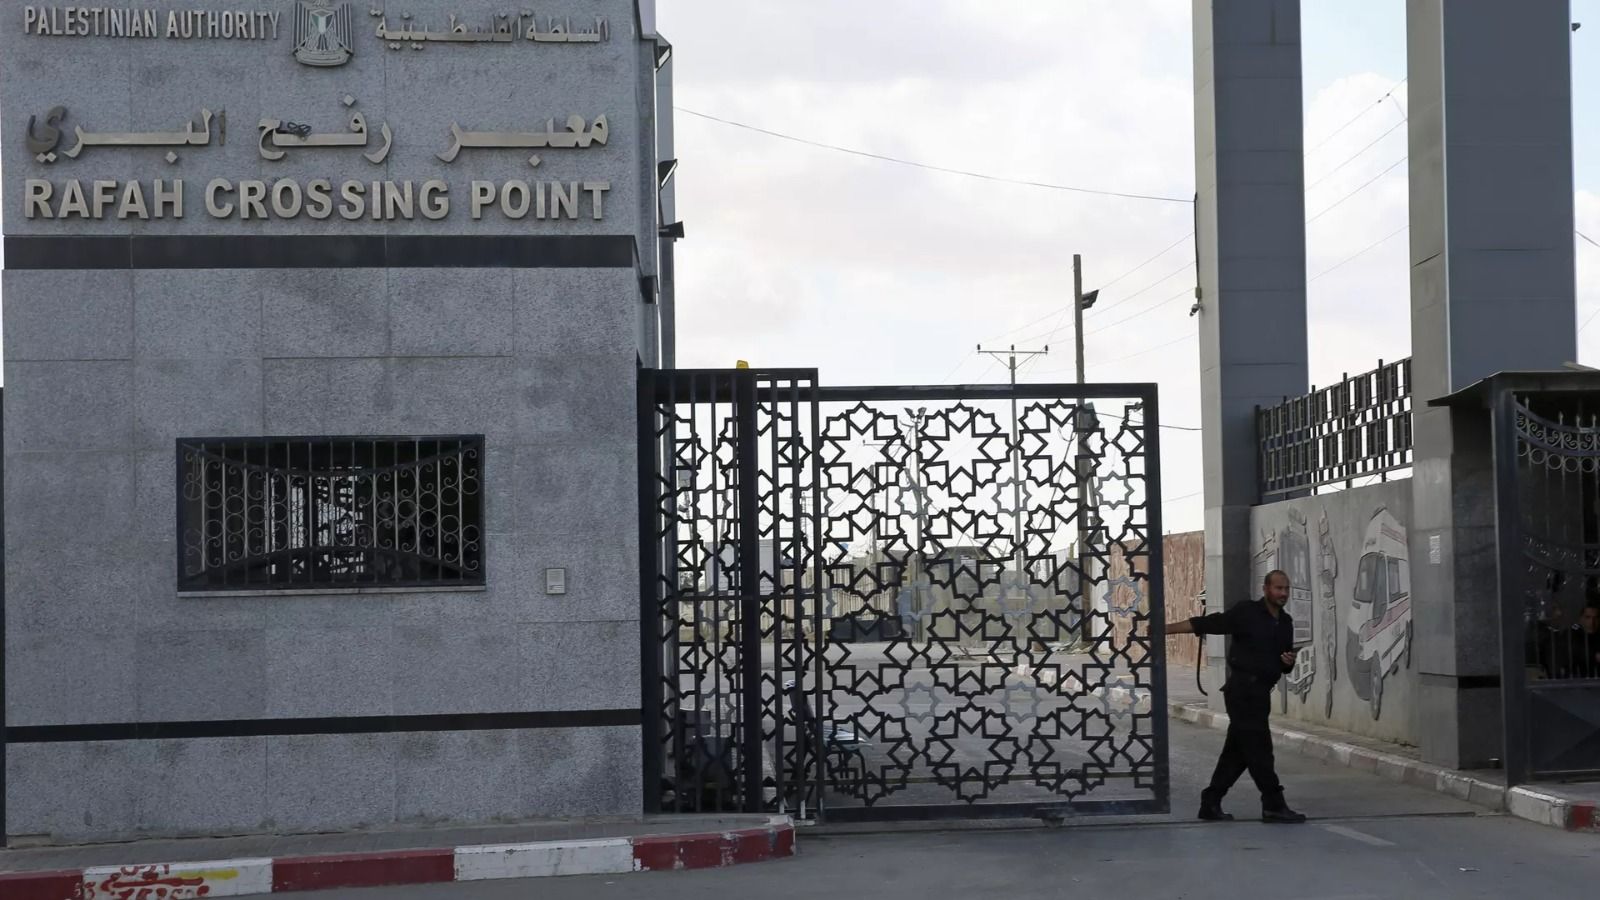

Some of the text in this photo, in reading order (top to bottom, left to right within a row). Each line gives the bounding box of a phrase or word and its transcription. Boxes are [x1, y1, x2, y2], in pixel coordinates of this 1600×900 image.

[24, 7, 280, 39] PALESTINIAN AUTHORITY
[369, 8, 610, 50] السلطة الفلسطينية
[25, 94, 609, 166] معبر رفح البري
[25, 178, 611, 220] RAFAH CROSSING POINT
